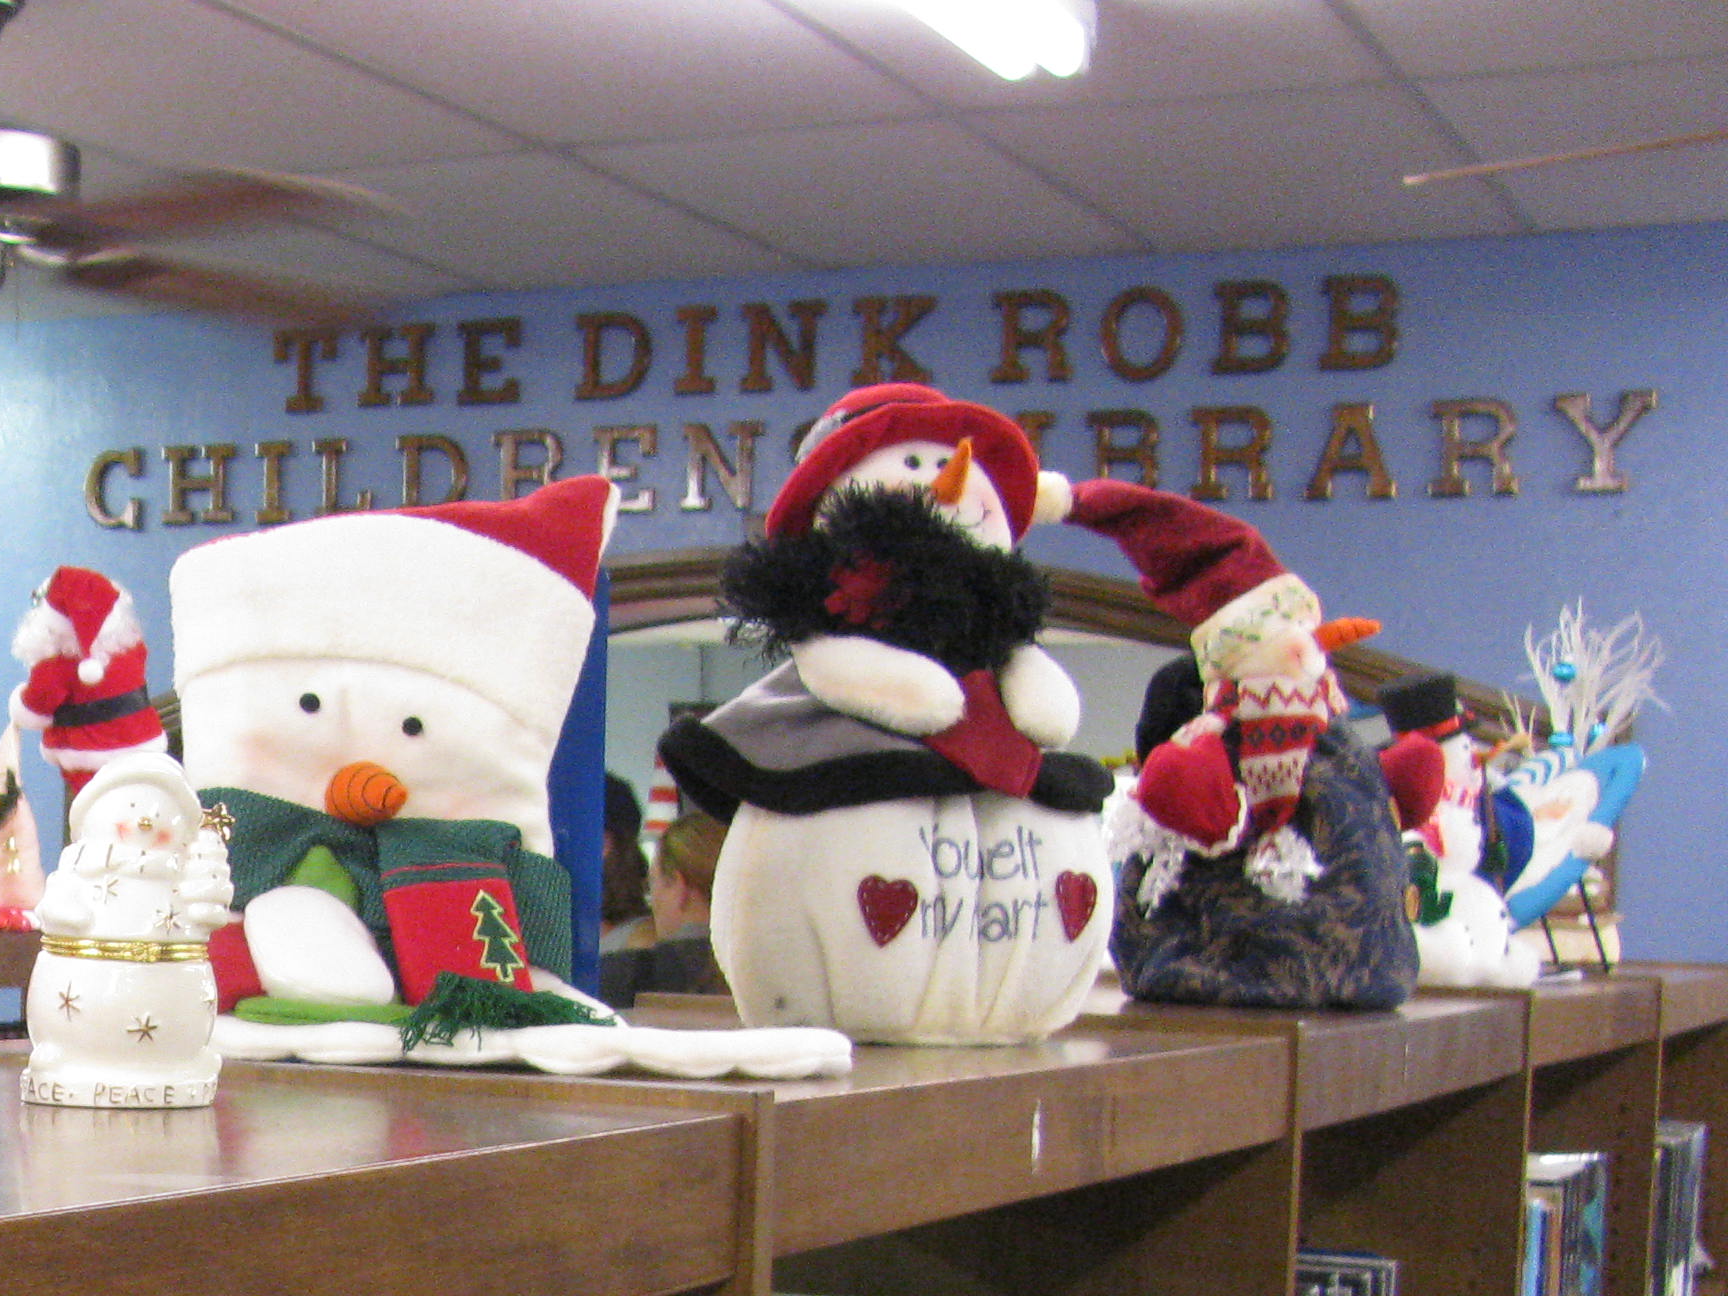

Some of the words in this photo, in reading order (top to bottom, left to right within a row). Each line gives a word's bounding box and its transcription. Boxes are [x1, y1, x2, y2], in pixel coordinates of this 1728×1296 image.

[274, 318, 524, 415] THE
[573, 293, 941, 403] DINK
[989, 272, 1403, 384] ROBB
[83, 418, 812, 532] CHILDREN
[1025, 388, 1659, 502] IBRARY
[93, 1081, 176, 1105] PEACE
